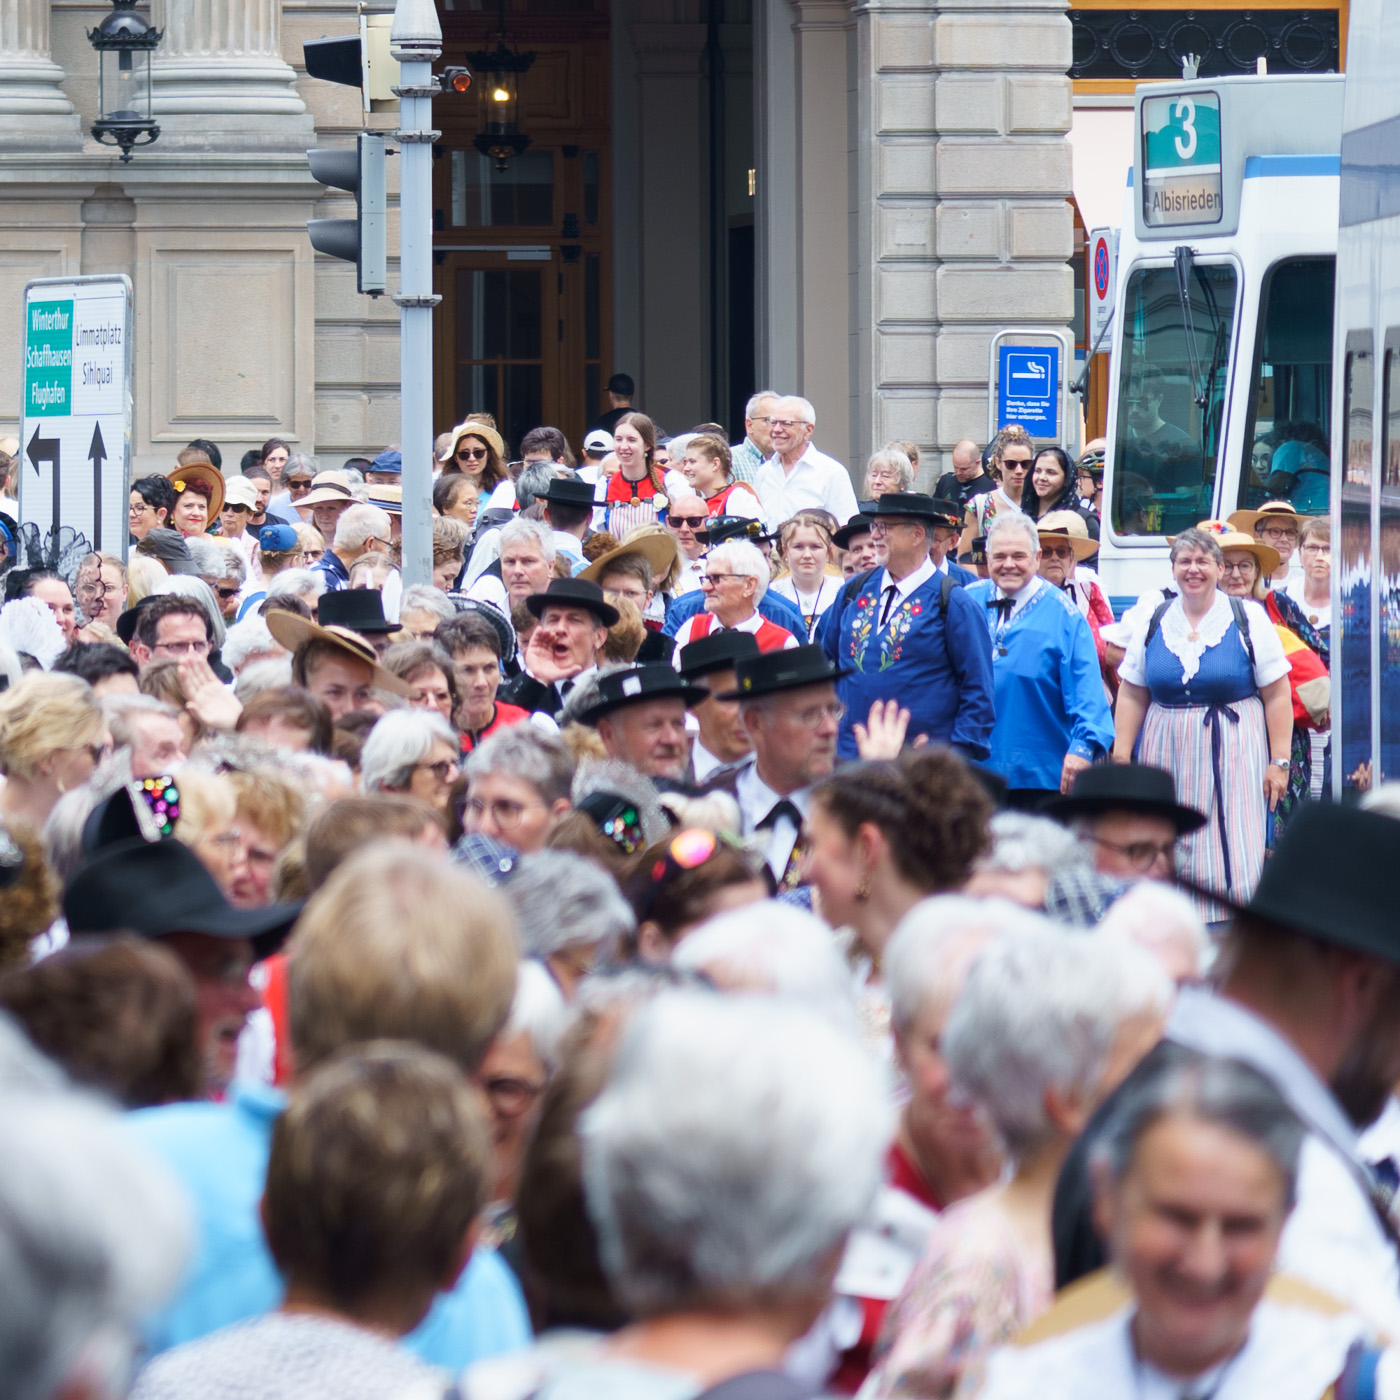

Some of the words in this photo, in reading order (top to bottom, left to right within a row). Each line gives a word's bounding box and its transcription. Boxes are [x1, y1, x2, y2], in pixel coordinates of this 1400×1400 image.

[1174, 96, 1198, 160] 3
[1152, 188, 1221, 213] Albisrieden
[32, 307, 70, 332] Winterthur
[76, 320, 122, 352] Limmatplatz
[27, 344, 72, 369] Schaffhausen
[82, 360, 113, 392] Sihlquai
[31, 380, 66, 411] Flughafen
